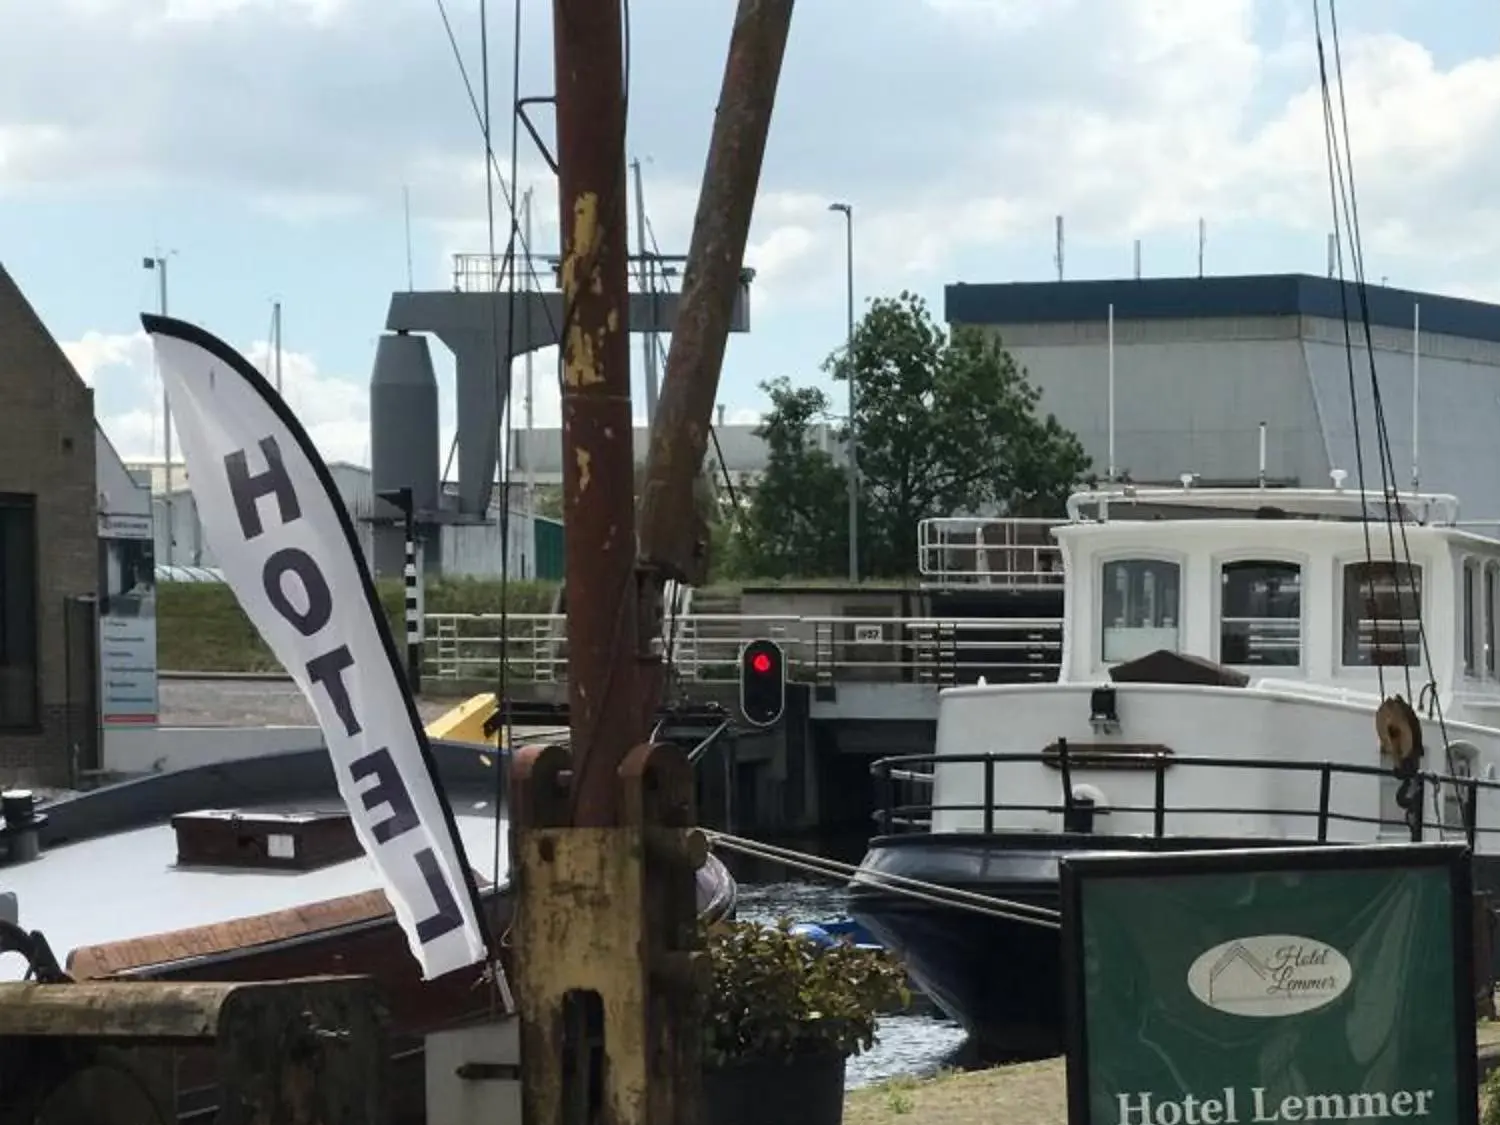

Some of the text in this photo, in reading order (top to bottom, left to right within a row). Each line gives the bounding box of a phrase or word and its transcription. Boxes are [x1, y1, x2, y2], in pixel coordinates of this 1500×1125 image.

[1266, 945, 1330, 971] Hotel
[1266, 966, 1337, 996] Lemmer
[1251, 1086, 1435, 1123] Lemmer
